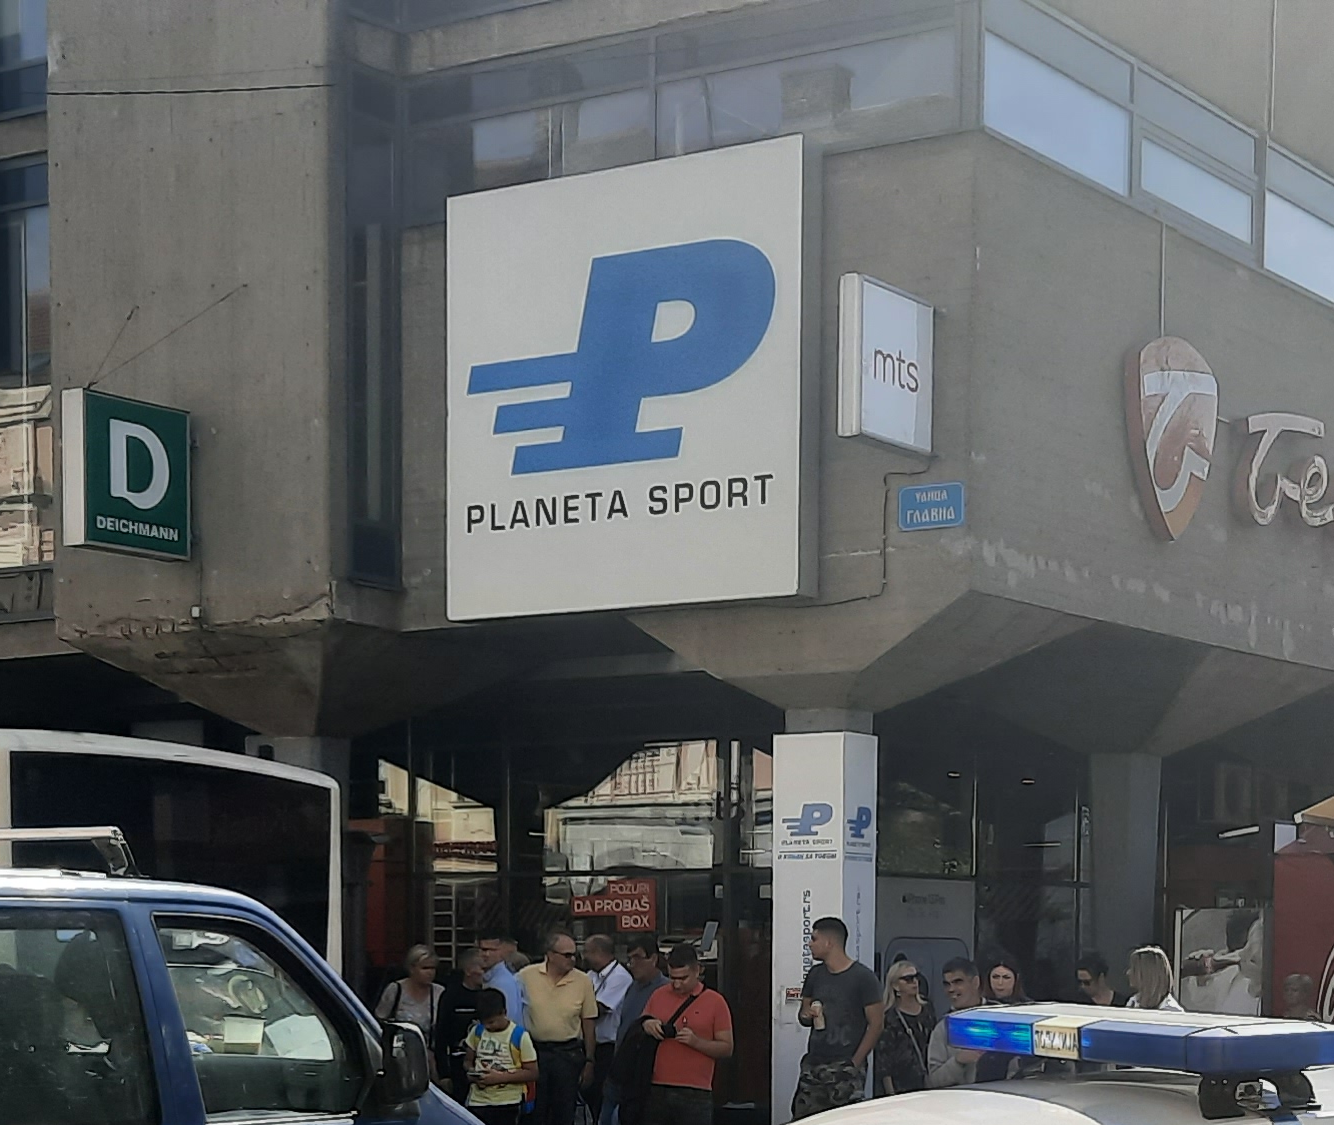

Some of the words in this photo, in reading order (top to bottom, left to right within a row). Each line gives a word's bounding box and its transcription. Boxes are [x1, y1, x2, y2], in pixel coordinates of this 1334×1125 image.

[873, 348, 919, 393] mts
[109, 418, 170, 510] D
[467, 489, 628, 533] PLANETA
[647, 473, 774, 516] SPORT
[906, 506, 956, 525] ГЛАВНА
[95, 515, 179, 541] DEICHMANN
[574, 901, 593, 913] DA
[594, 895, 650, 912] PROBAŠ
[621, 915, 650, 928] BOX
